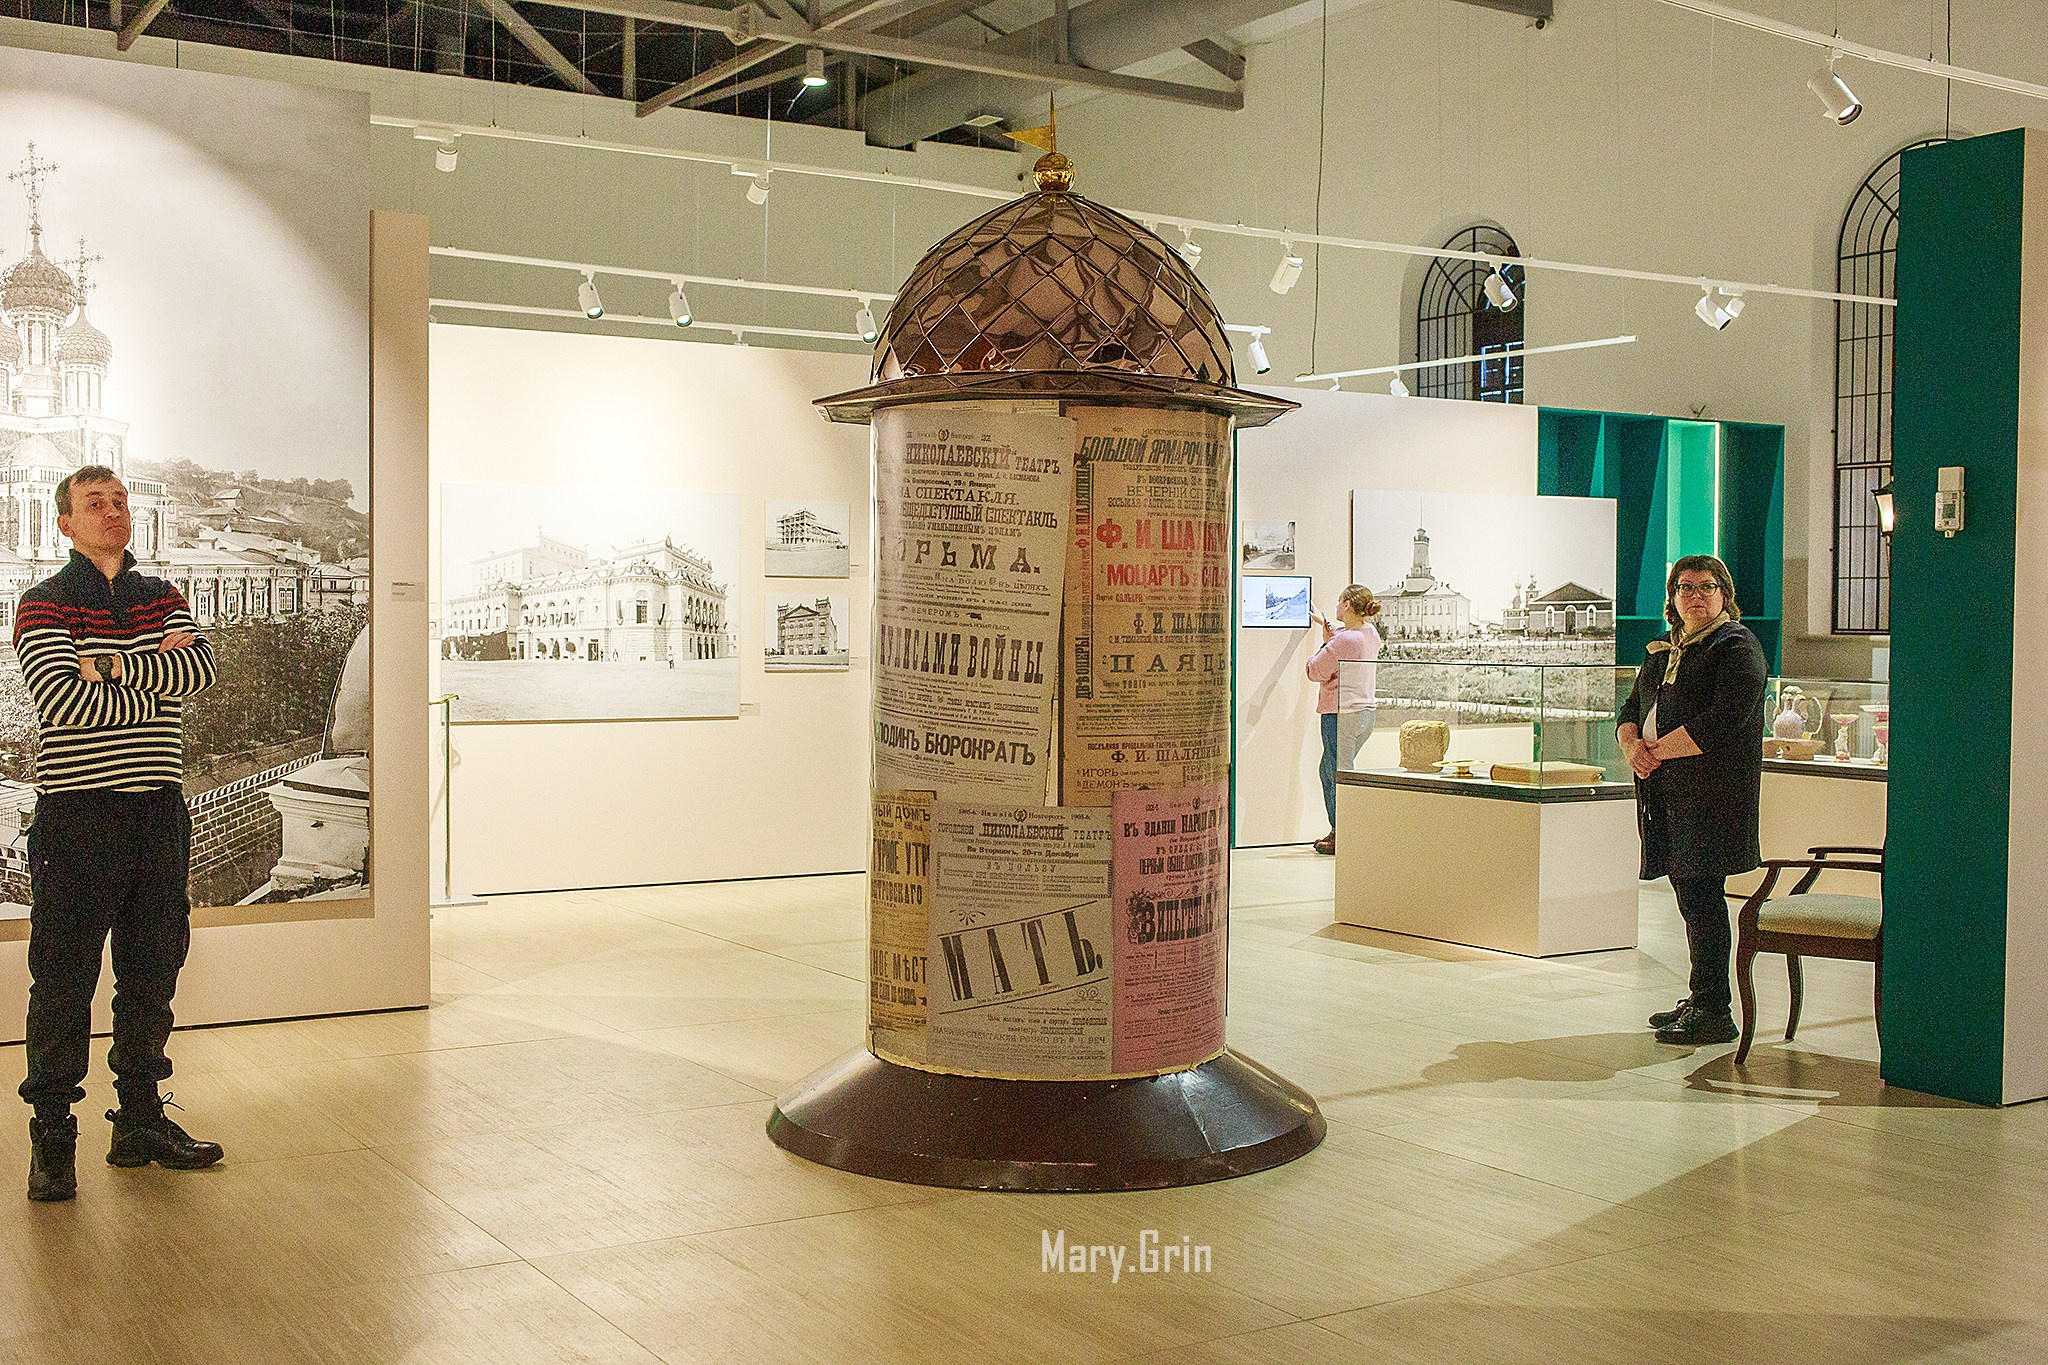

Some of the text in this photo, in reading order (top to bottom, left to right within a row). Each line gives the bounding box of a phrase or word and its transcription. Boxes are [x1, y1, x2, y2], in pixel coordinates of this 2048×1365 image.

[1080, 434, 1148, 463] БОЛЬШОЙ
[1015, 455, 1062, 475] ТЕАТРЪ.
[968, 480, 996, 490] Января
[1126, 485, 1187, 498] ВЕЧЕРНІЙ
[915, 486, 1019, 506] СПЕКТАКЛЯ.
[985, 506, 1058, 529] СПЕКТАКЛЬ
[1096, 518, 1128, 549] Ф.
[1135, 518, 1156, 549] И.
[880, 536, 1041, 575] РЬМА.
[1107, 563, 1190, 589] МОЦАРТЪ
[911, 606, 960, 618] ВЕЧЕРОМЪ
[1133, 612, 1147, 634] Ф.
[1152, 612, 1166, 634] И.
[1075, 636, 1090, 675] ОПЕРЫ
[925, 731, 1036, 766] БЮРОКРАТЪ
[1111, 750, 1129, 763] Ф.
[1134, 750, 1150, 763] И.
[1082, 768, 1119, 778] ИГОРЬ
[1082, 779, 1129, 790] ДЕМОНЪ
[895, 805, 931, 823] ДОМЪ
[1073, 829, 1112, 841] ТЕАТРЪ
[1123, 821, 1139, 838] ВЪ
[1045, 849, 1079, 859] Декабря
[940, 910, 1103, 1001] МАТЬ.
